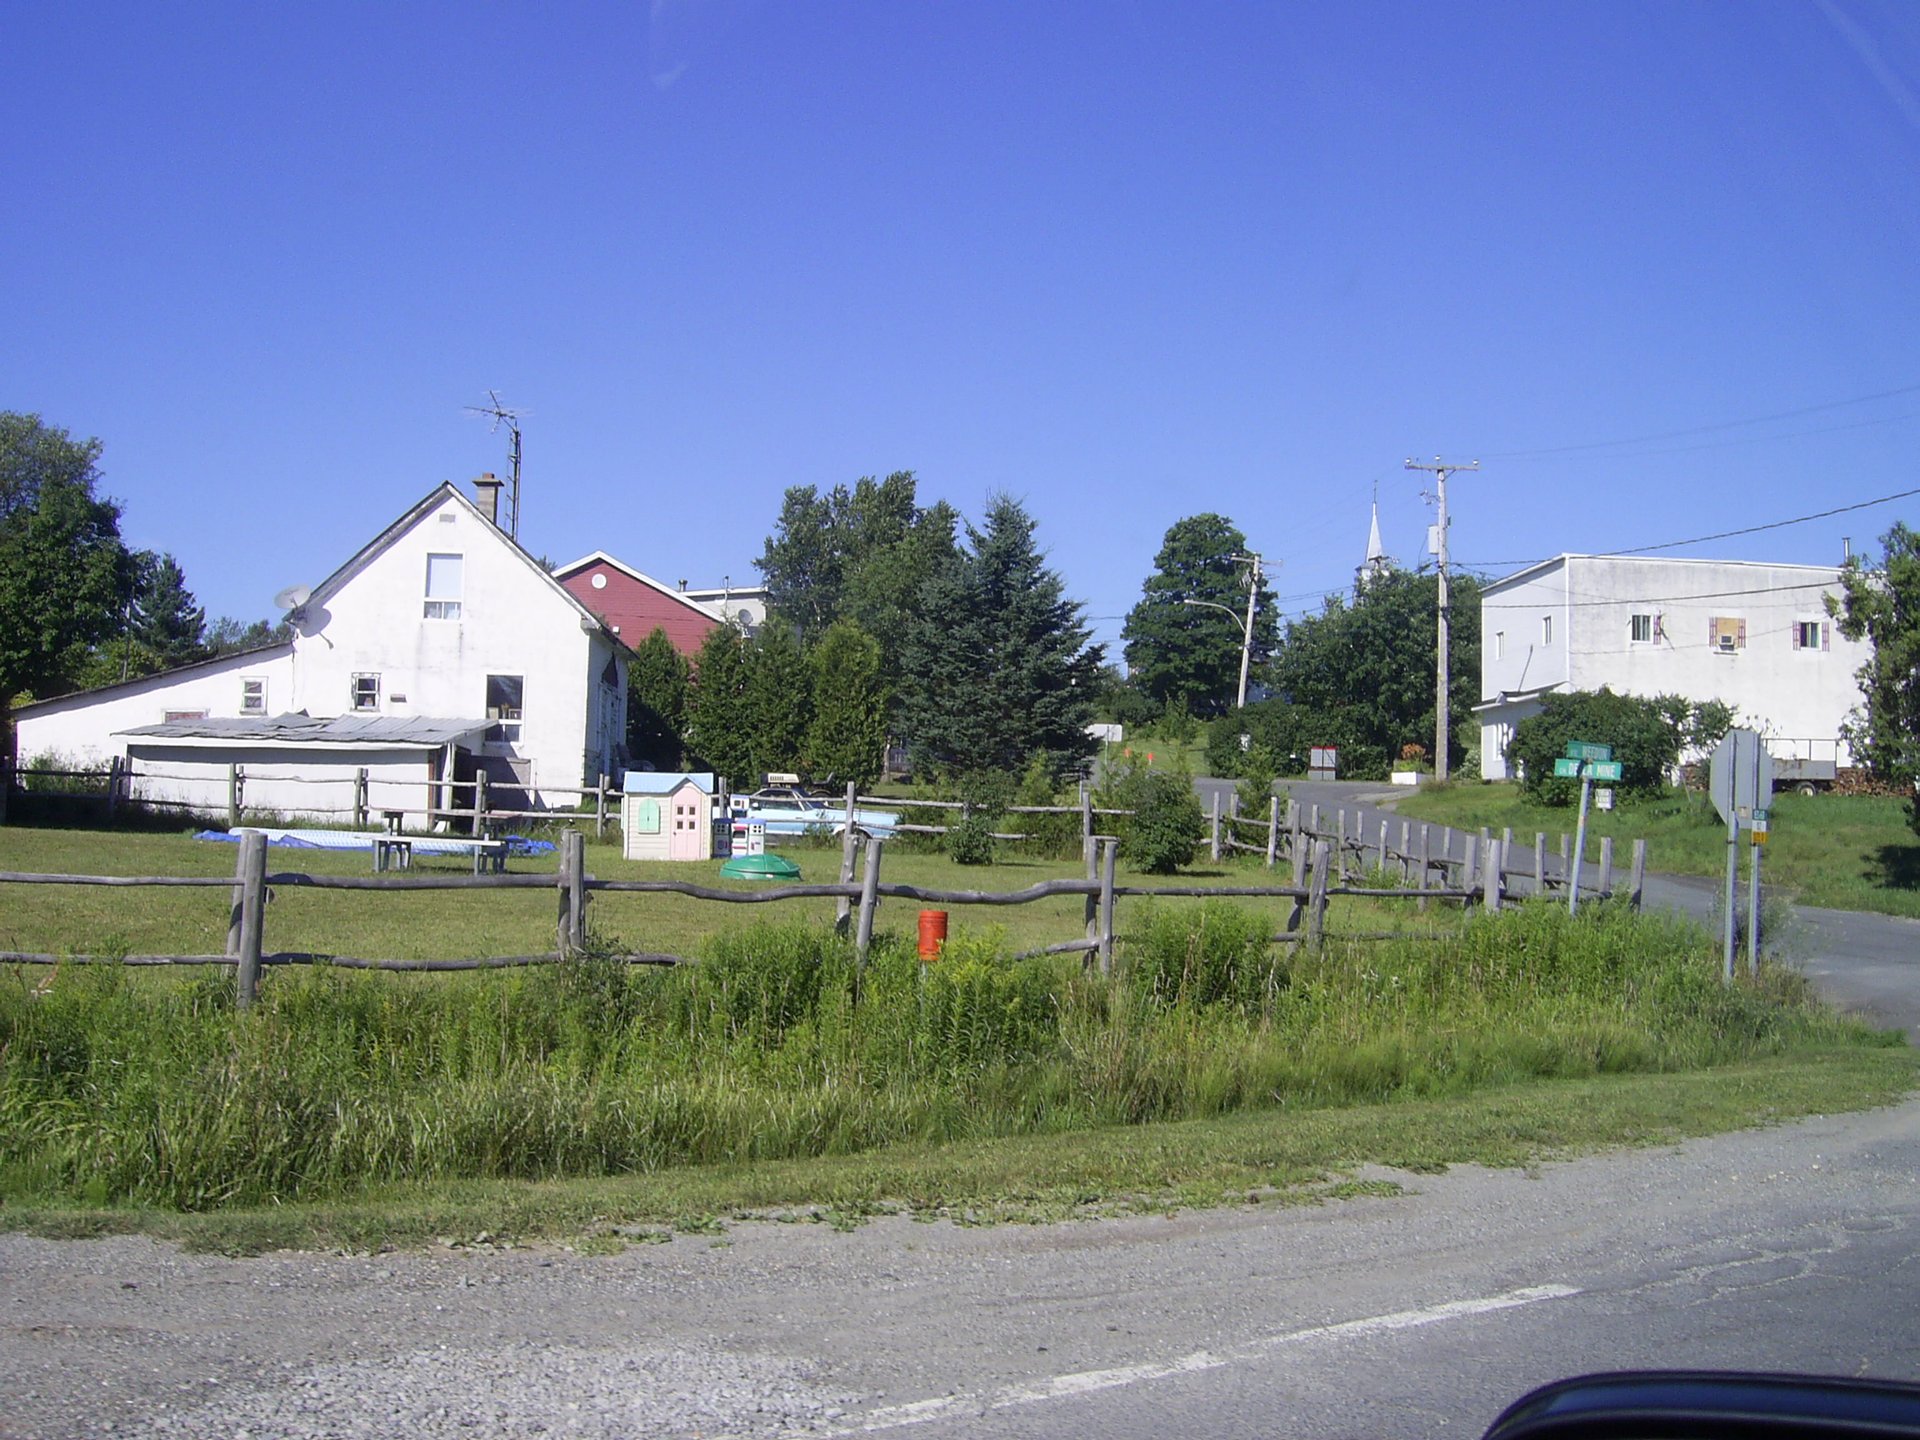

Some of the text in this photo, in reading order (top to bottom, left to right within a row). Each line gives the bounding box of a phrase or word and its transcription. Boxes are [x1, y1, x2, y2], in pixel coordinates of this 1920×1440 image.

[1568, 762, 1579, 776] DE
[1582, 764, 1593, 777] LA
[1596, 764, 1616, 778] MINE
